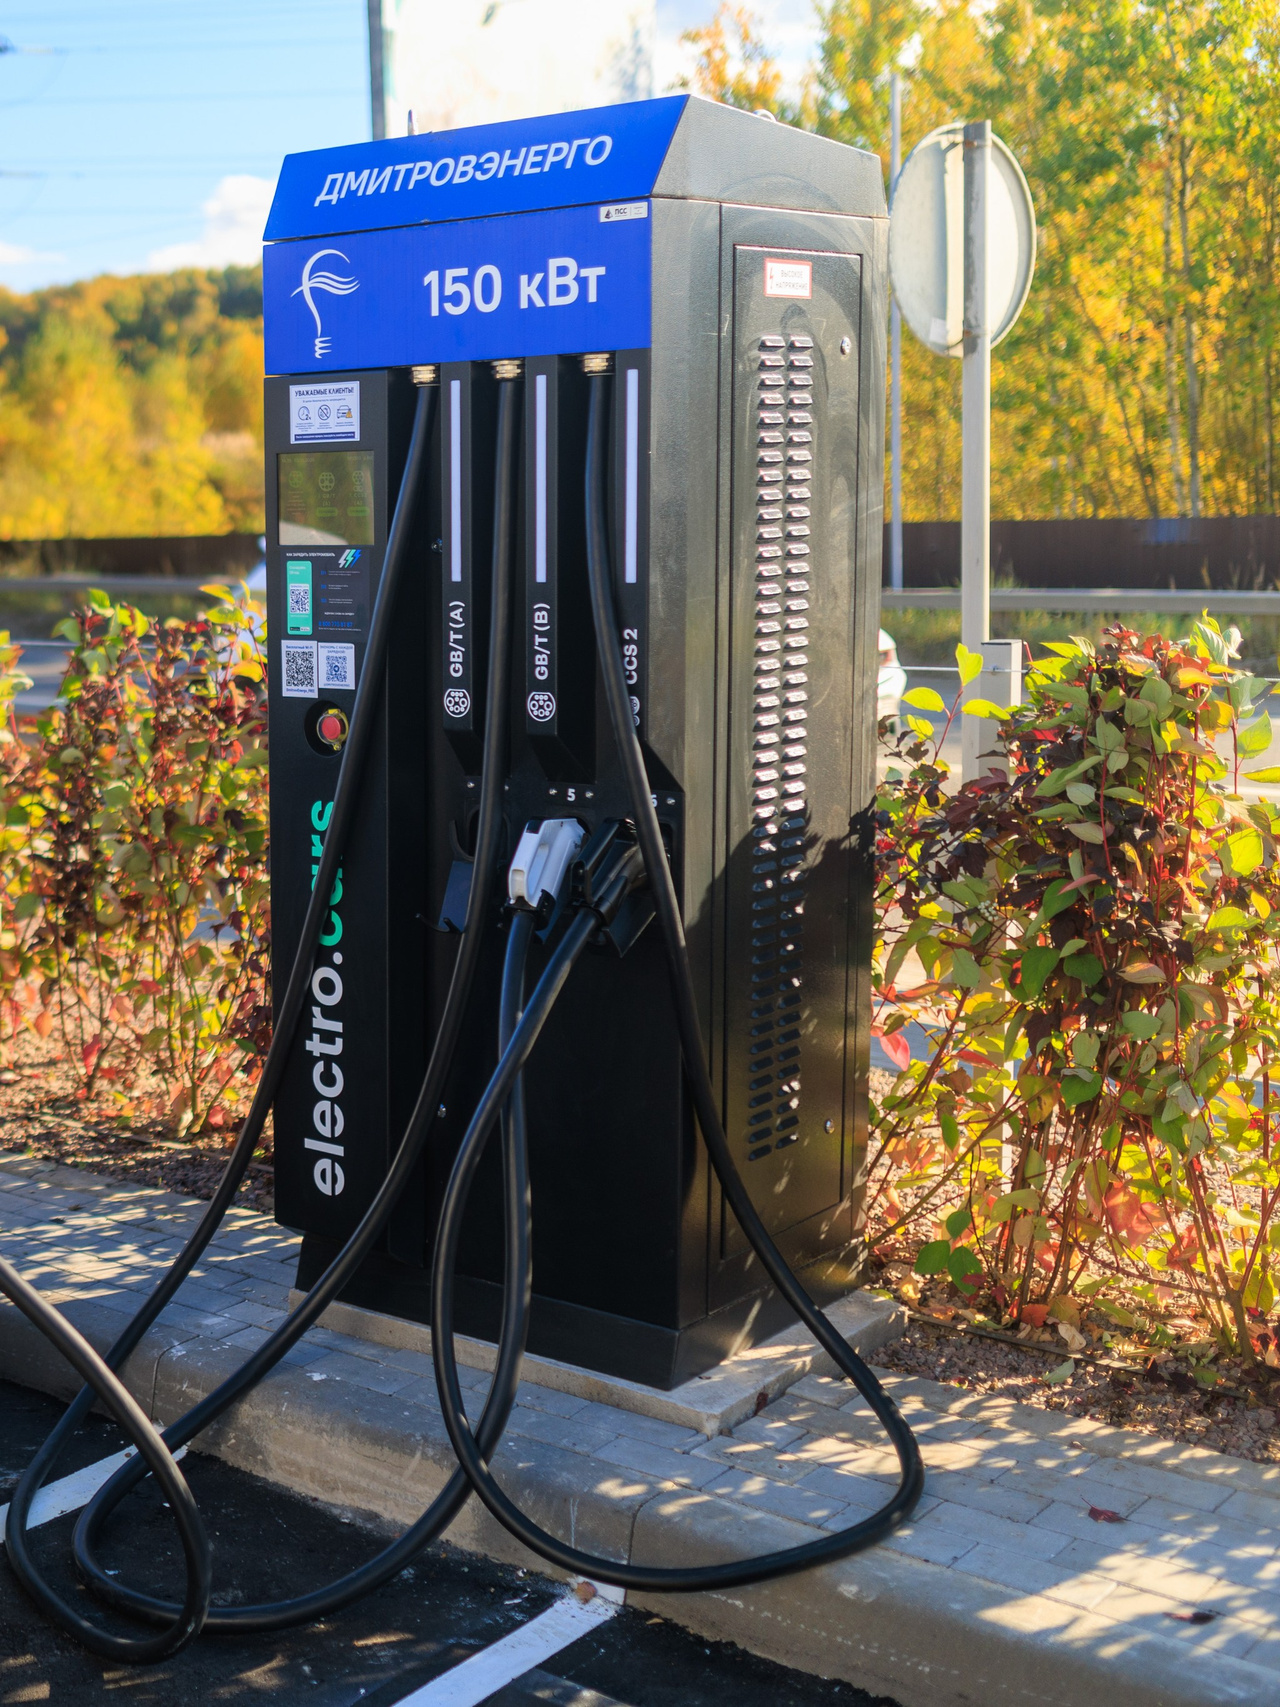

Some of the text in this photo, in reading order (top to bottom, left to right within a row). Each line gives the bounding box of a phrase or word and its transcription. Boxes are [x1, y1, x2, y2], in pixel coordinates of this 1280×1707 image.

[314, 134, 613, 208] ДМИТРОВЭНЕРГО
[423, 256, 606, 317] 150 кВт
[294, 387, 355, 397] УВАЖАЕМЫЕ КЛИЕНТЫ!
[623, 628, 638, 685] CCS 2
[566, 787, 576, 802] 5
